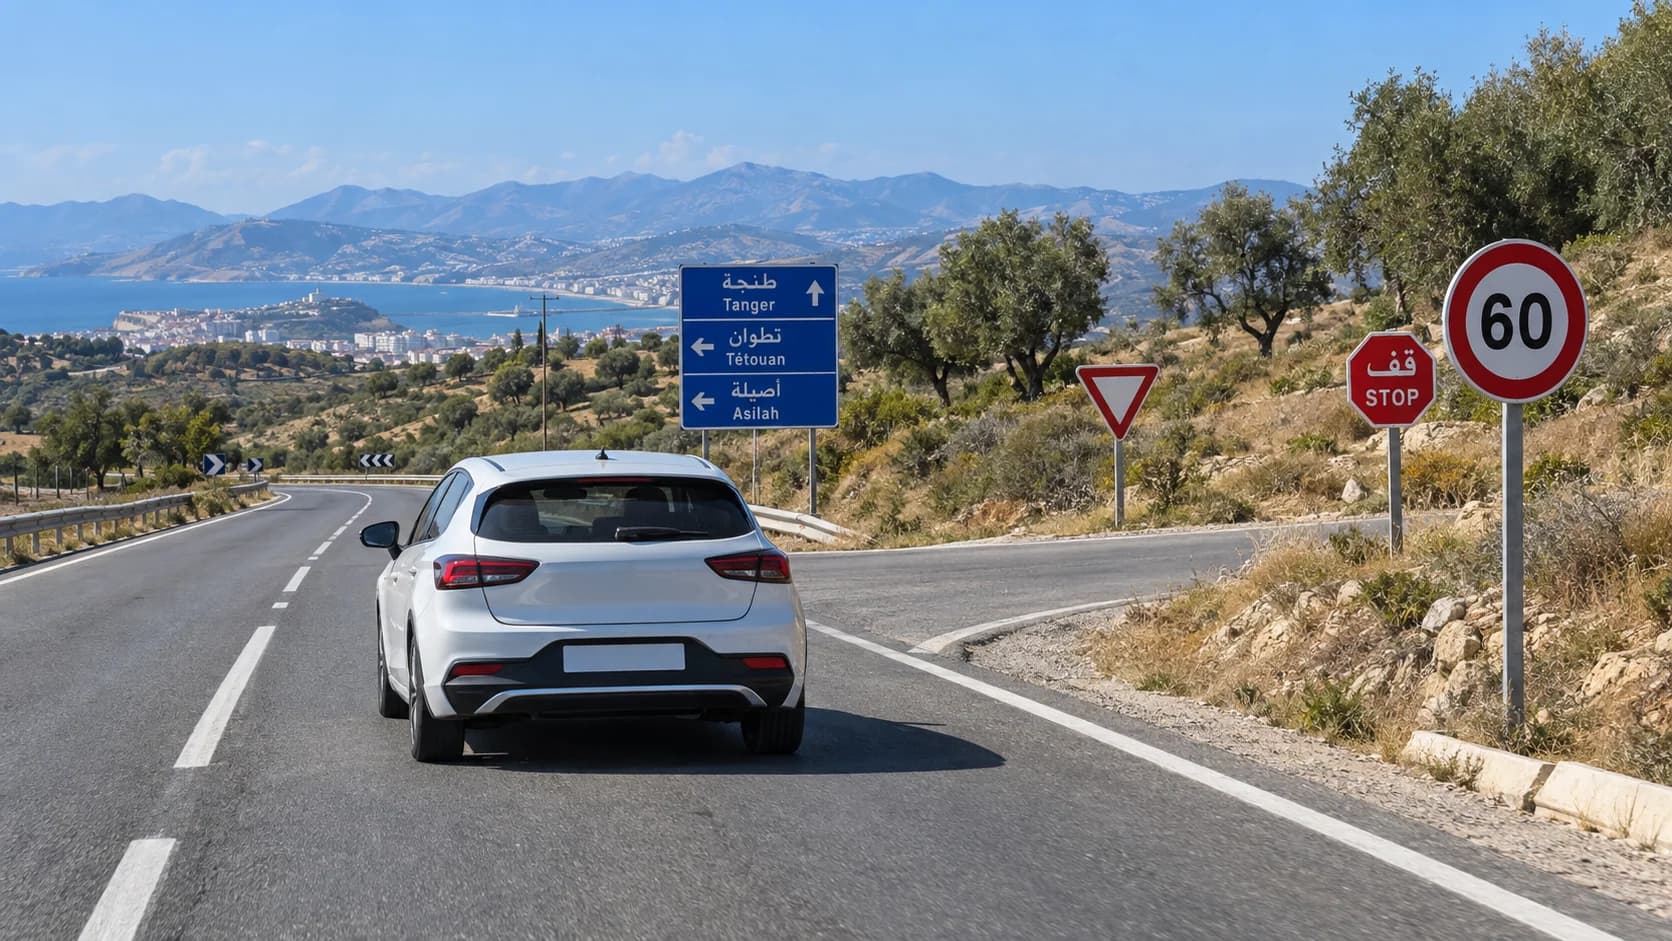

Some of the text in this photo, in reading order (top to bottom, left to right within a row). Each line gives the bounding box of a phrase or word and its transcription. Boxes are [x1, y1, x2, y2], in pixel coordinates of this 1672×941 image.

[723, 272, 777, 294] طنجة
[723, 298, 776, 315] Tanger
[1481, 292, 1552, 350] 60
[729, 327, 782, 348] تطوان
[726, 352, 785, 366] Tétouan
[1367, 349, 1417, 377] قف
[731, 378, 781, 402] أصيلة
[1365, 388, 1420, 407] STOP
[733, 406, 779, 420] Asilah
